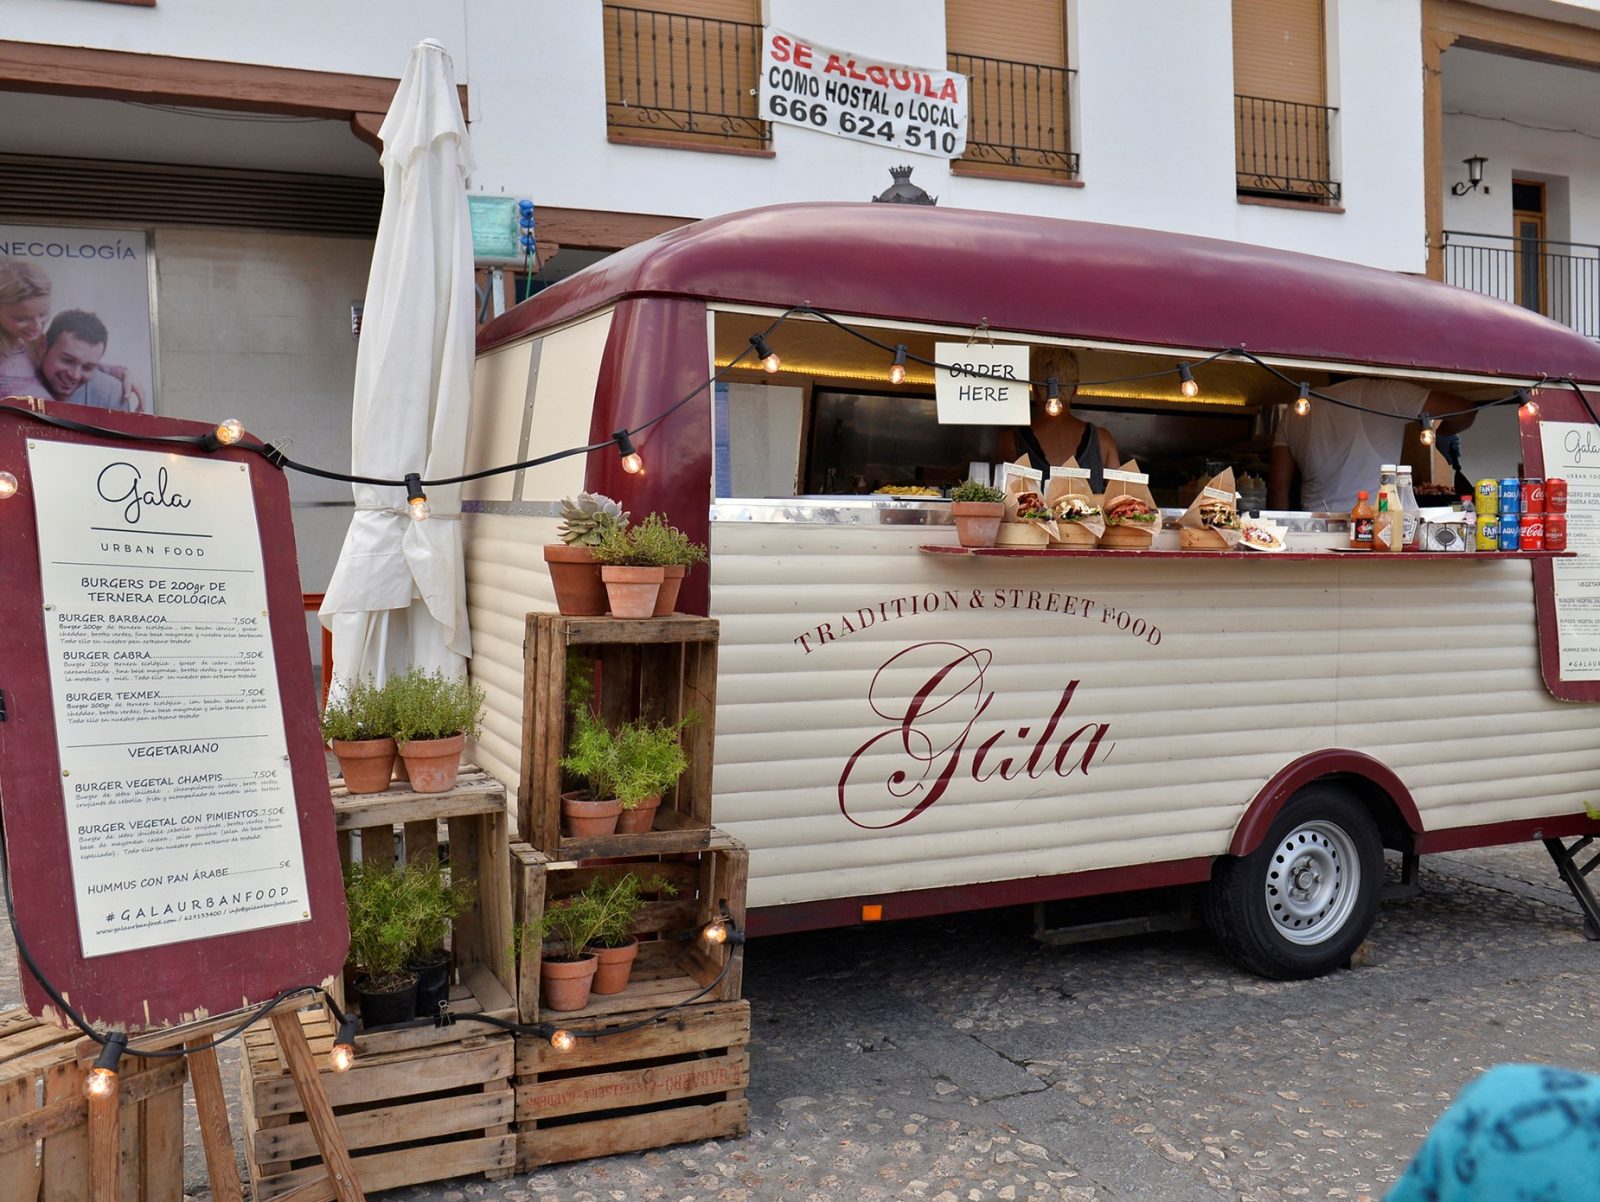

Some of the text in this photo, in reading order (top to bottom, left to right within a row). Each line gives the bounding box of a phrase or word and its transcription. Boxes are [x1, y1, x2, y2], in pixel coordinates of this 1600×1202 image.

[770, 35, 959, 103] SE ALQUILA
[769, 66, 819, 97] COMO
[825, 80, 890, 115] HOSTAL
[909, 99, 959, 129] LOCAL
[769, 95, 956, 154] 666 624 510
[950, 363, 1016, 380] ORDER
[960, 385, 1008, 401] HERE
[98, 462, 191, 523] Gala
[101, 543, 204, 556] URBAN FOOD
[81, 577, 225, 594] BURGERS DE 200gr DE
[88, 591, 226, 604] TERNERA ECOLÓGICA
[59, 613, 105, 622] BURGER
[109, 614, 167, 623] BARBACOA
[794, 588, 1164, 656] TRADITION & STREET FOOD
[63, 651, 110, 660] BURGER
[113, 651, 151, 659] CABRA
[66, 692, 112, 702] BURGER
[116, 691, 160, 699] TEXMEX
[838, 642, 1116, 829] Gala
[128, 743, 218, 757] VEGETARIANO
[75, 781, 123, 792] BURGER
[126, 778, 173, 788] VEGETAL
[177, 773, 222, 784] CHAMPIS
[78, 822, 126, 835] BURGER
[129, 817, 177, 829] VEGETAL
[180, 814, 201, 824] CON
[206, 809, 258, 821] PIMIENTOS
[88, 880, 136, 894] HUMMUS
[140, 876, 162, 887] CON
[167, 873, 188, 883] PAN
[192, 868, 228, 880] ÁRABE
